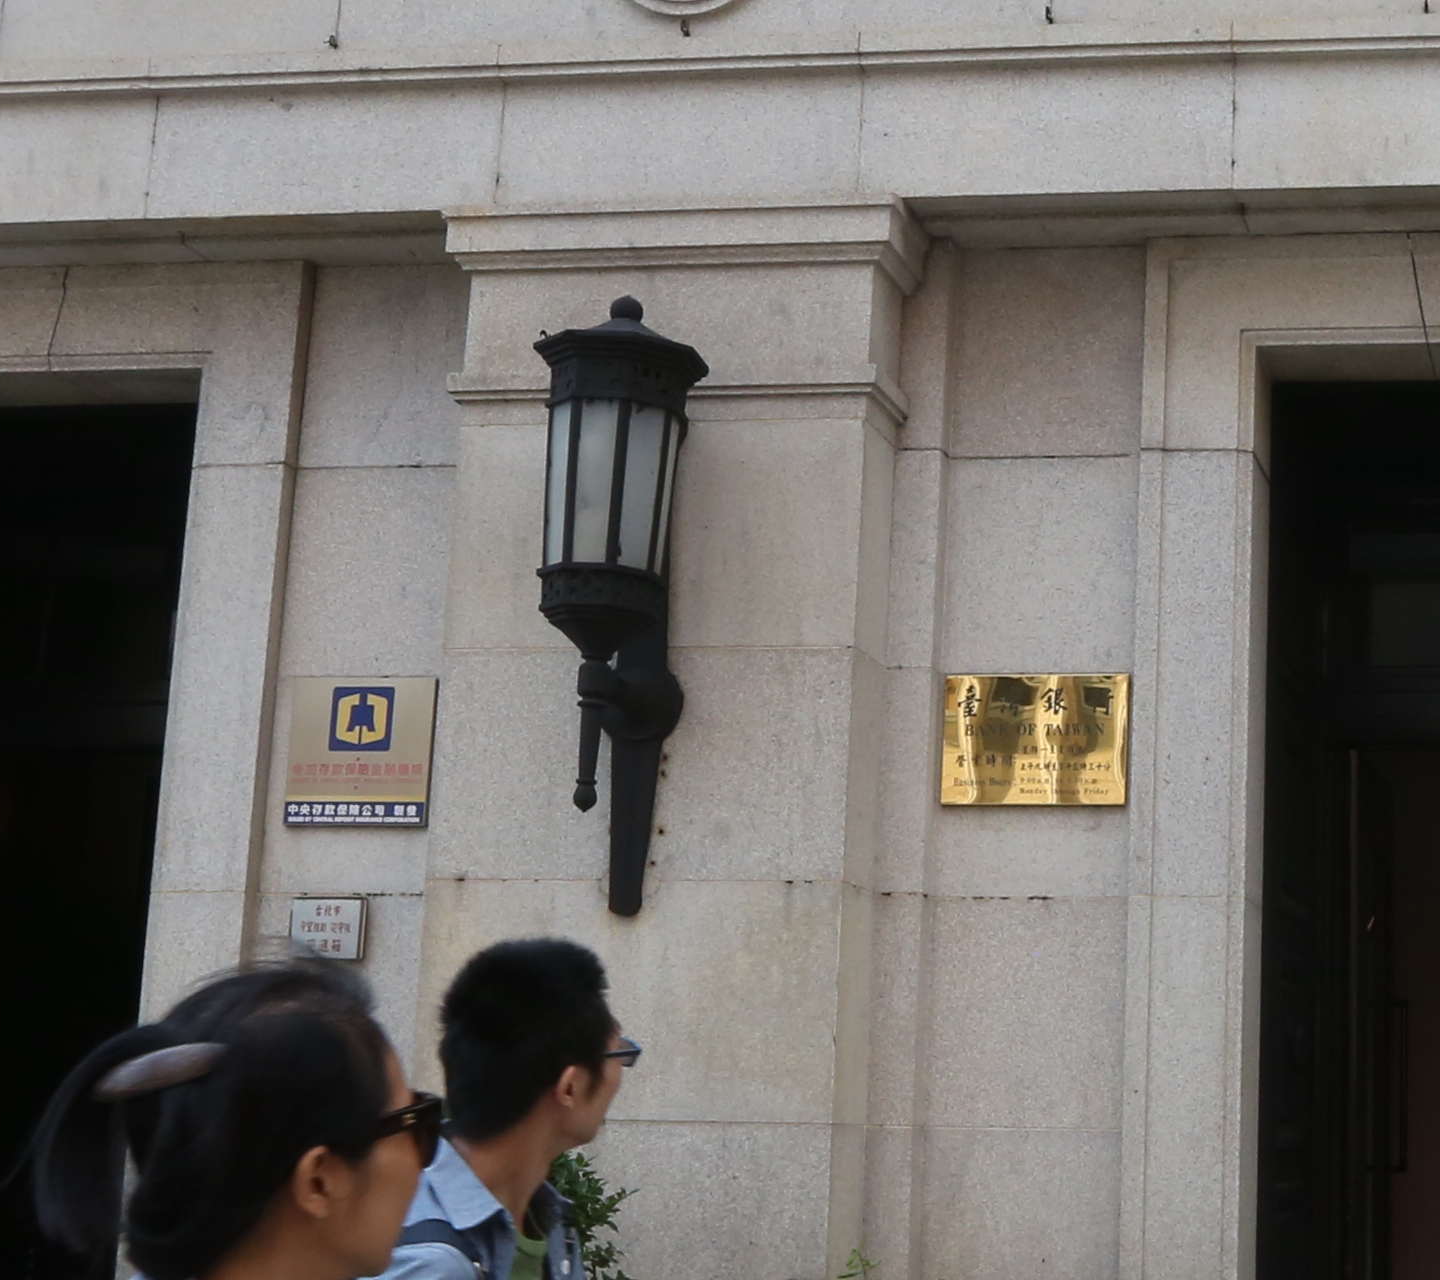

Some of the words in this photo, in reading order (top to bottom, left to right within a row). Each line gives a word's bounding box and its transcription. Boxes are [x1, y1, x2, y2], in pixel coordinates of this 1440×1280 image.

[965, 723, 1007, 736] BANK
[1017, 723, 1037, 736] OF
[1045, 723, 1105, 736] TAIWAN
